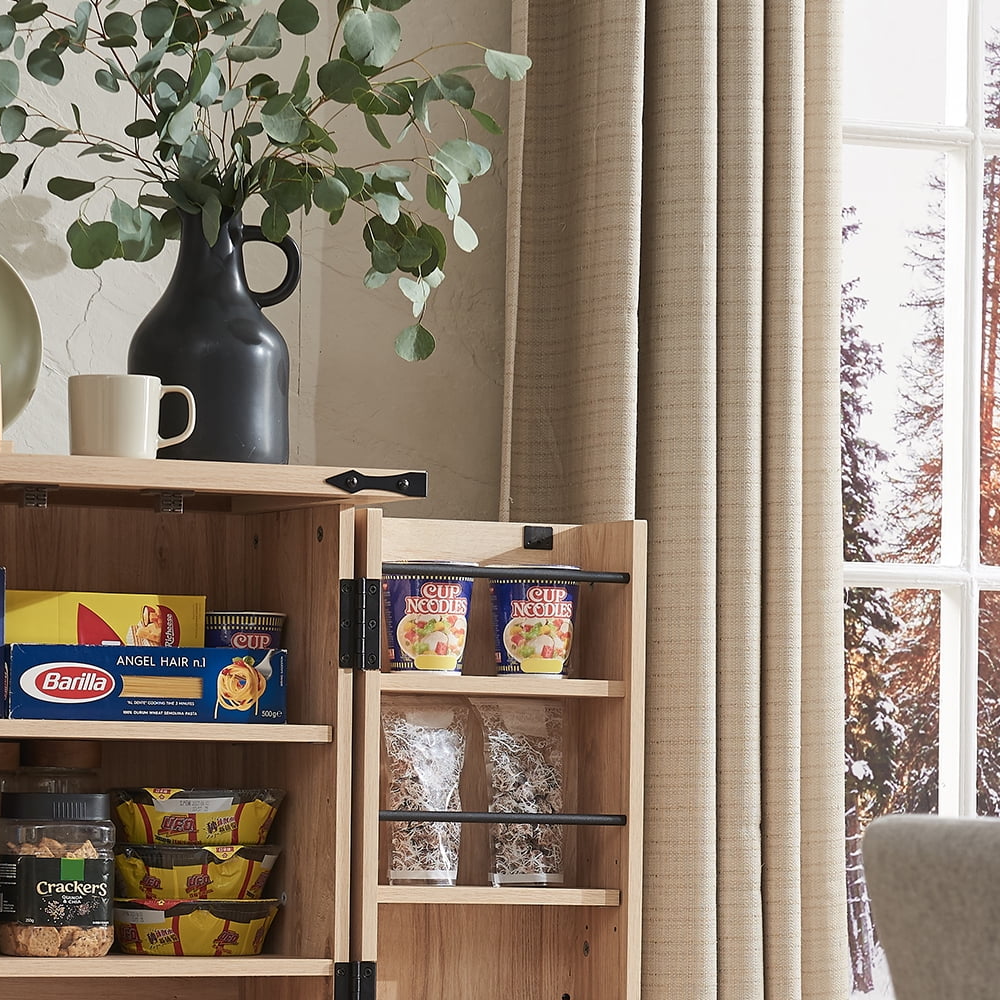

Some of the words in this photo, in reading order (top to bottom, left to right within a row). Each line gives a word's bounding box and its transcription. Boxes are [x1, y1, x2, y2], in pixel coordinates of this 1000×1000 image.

[422, 583, 460, 599] CUP
[528, 587, 567, 602] CUP
[406, 598, 468, 614] NOODLES
[512, 601, 573, 618] NOODLES
[233, 633, 271, 650] CUP
[116, 655, 156, 667] ANGEL
[160, 656, 189, 668] HAIR
[42, 671, 108, 692] Barilla
[36, 881, 108, 897] Crackers
